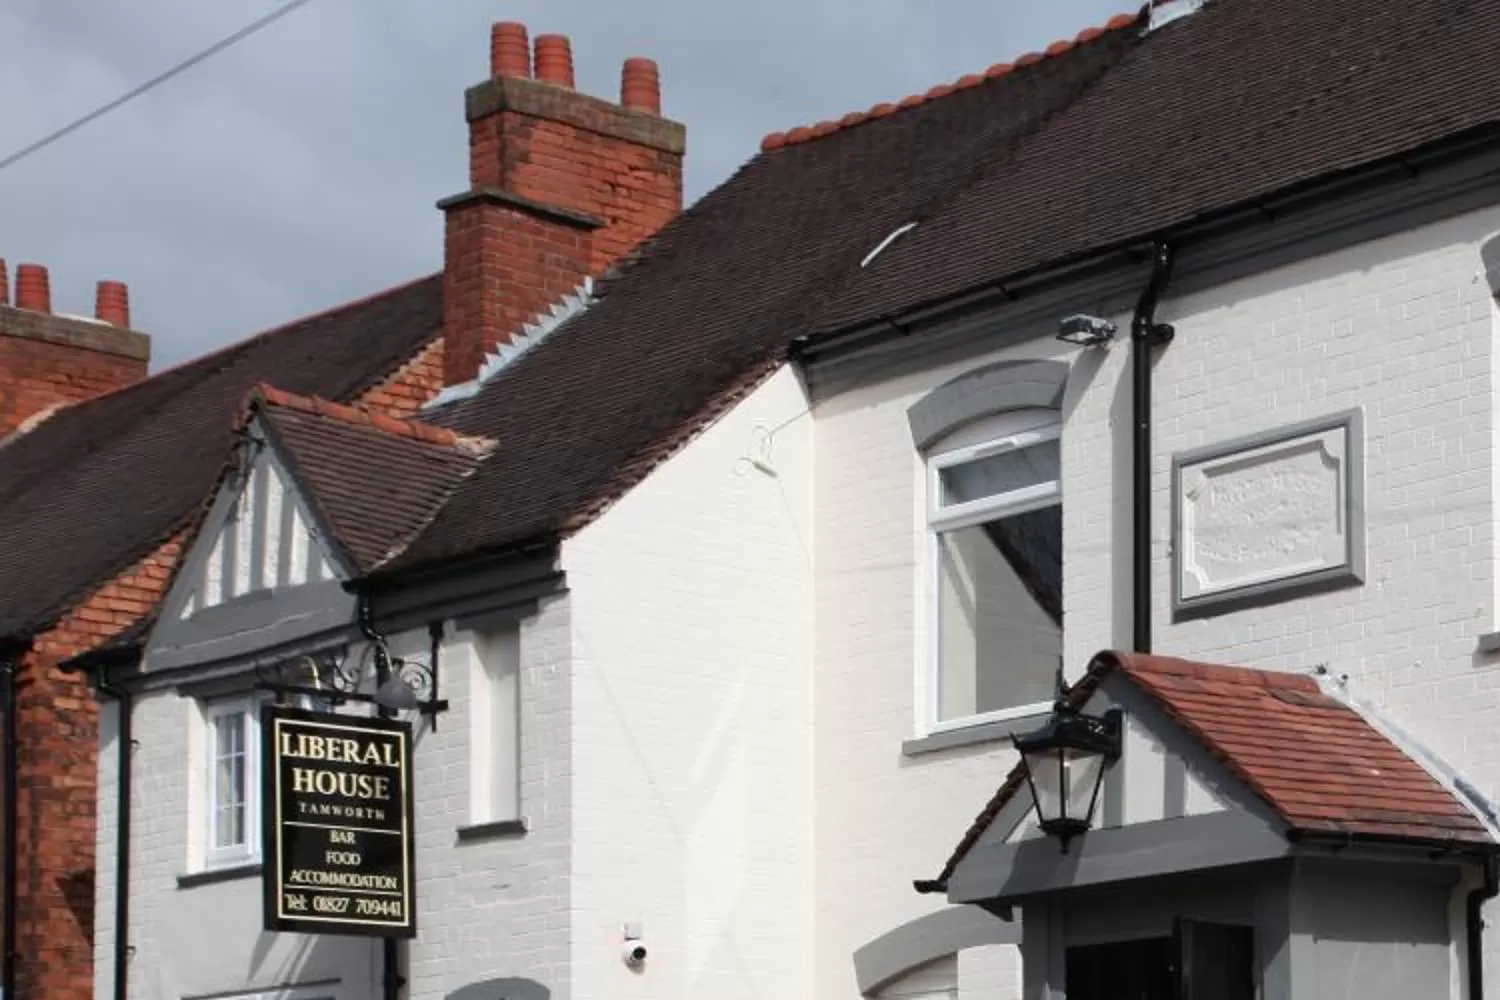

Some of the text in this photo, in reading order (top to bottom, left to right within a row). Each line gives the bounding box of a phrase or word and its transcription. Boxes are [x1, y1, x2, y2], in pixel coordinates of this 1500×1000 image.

[280, 732, 399, 767] LIBERAL
[292, 768, 390, 800] HOUSE
[299, 801, 385, 821] TAMWORTH
[330, 830, 356, 845] BAR
[325, 850, 361, 866] FOOD
[289, 868, 397, 889] ACCOMMODATION
[355, 898, 401, 917] 709441
